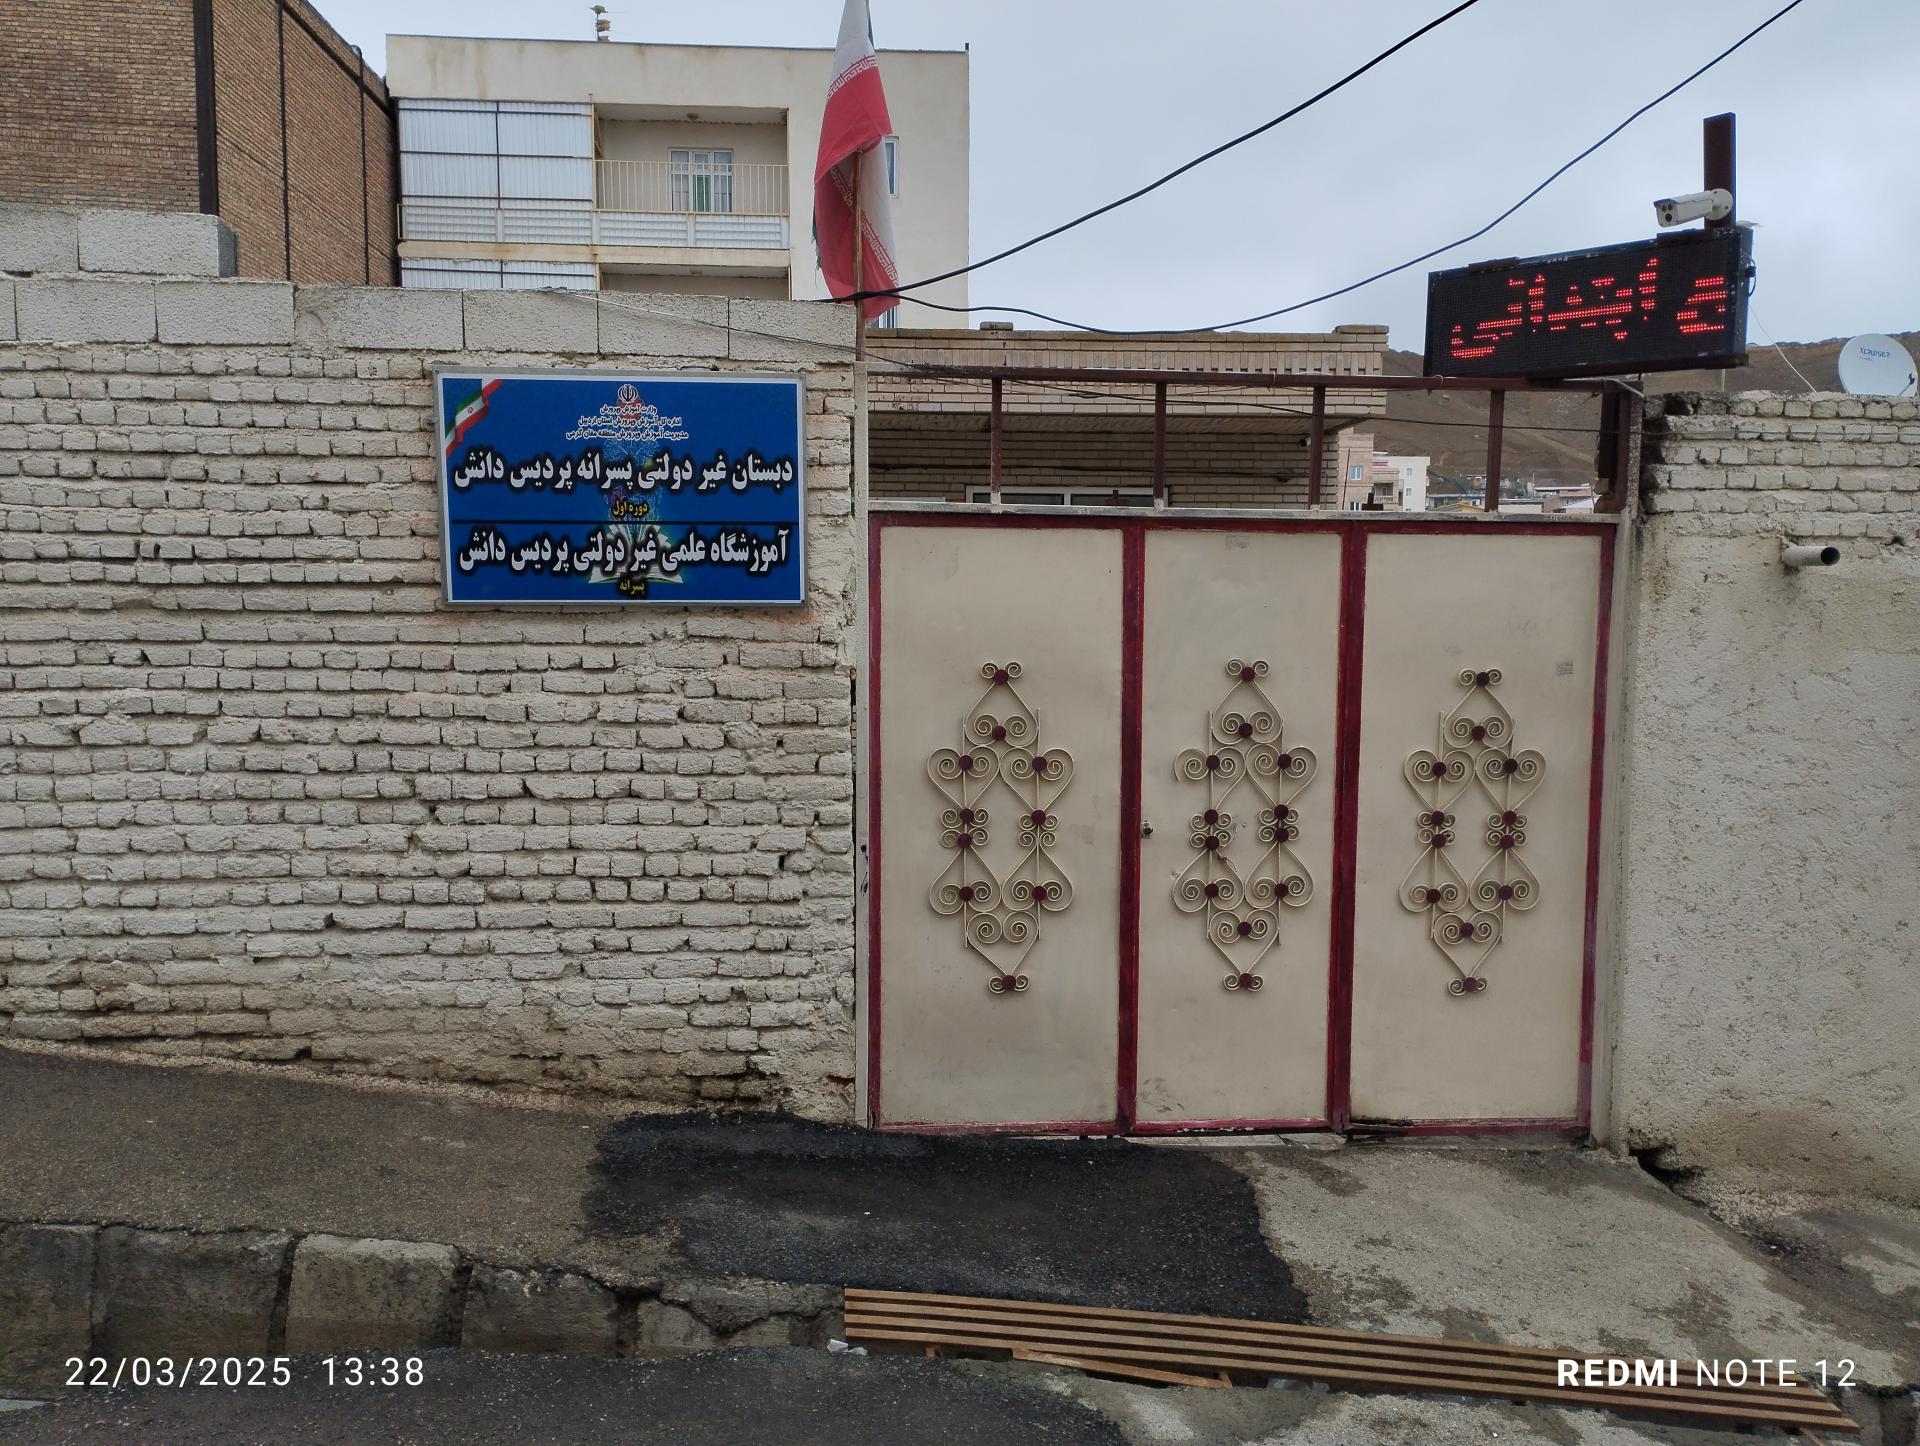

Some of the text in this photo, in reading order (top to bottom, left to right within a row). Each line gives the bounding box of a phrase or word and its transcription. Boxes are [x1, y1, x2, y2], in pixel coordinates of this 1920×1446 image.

[621, 404, 641, 415] آموزش
[578, 416, 597, 427] اردبیل
[596, 416, 613, 428] استان
[637, 415, 658, 428] آموزش
[641, 427, 664, 441] آموزش
[454, 450, 793, 490] دبستان غیر دولتی پسرانه پردیس دانش
[612, 500, 648, 515] دوره اول
[459, 529, 789, 573] آموزشگاه علمی غیر دولتی پردیس دانش
[619, 579, 645, 595] پسرانه
